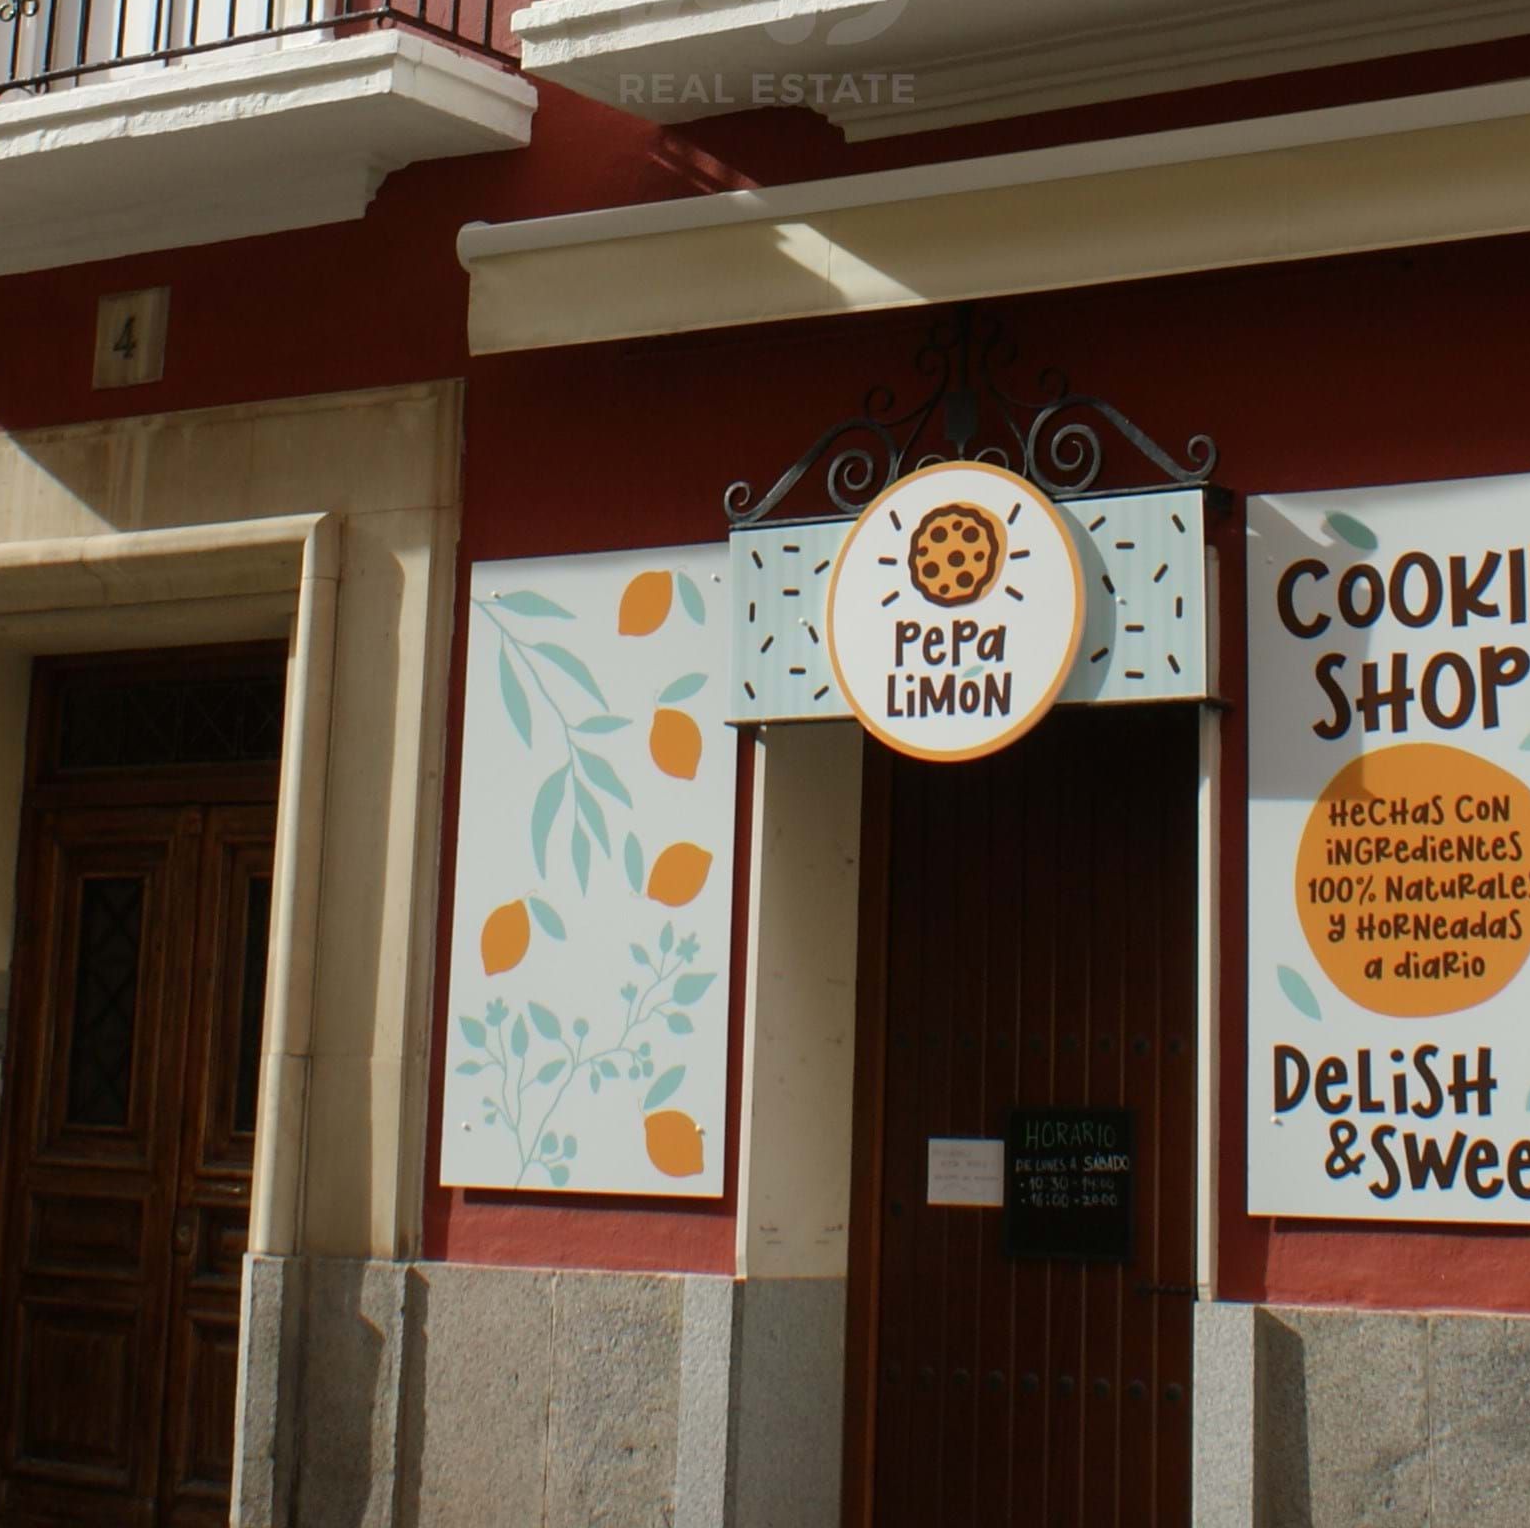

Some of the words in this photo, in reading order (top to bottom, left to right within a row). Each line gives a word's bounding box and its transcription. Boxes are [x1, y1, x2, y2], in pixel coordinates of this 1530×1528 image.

[111, 312, 138, 360] 4
[1312, 646, 1530, 741] SHOP
[1308, 875, 1377, 906] 100%
[1327, 913, 1346, 943] y
[1364, 956, 1383, 980] a
[1025, 1120, 1117, 1150] HORARIO
